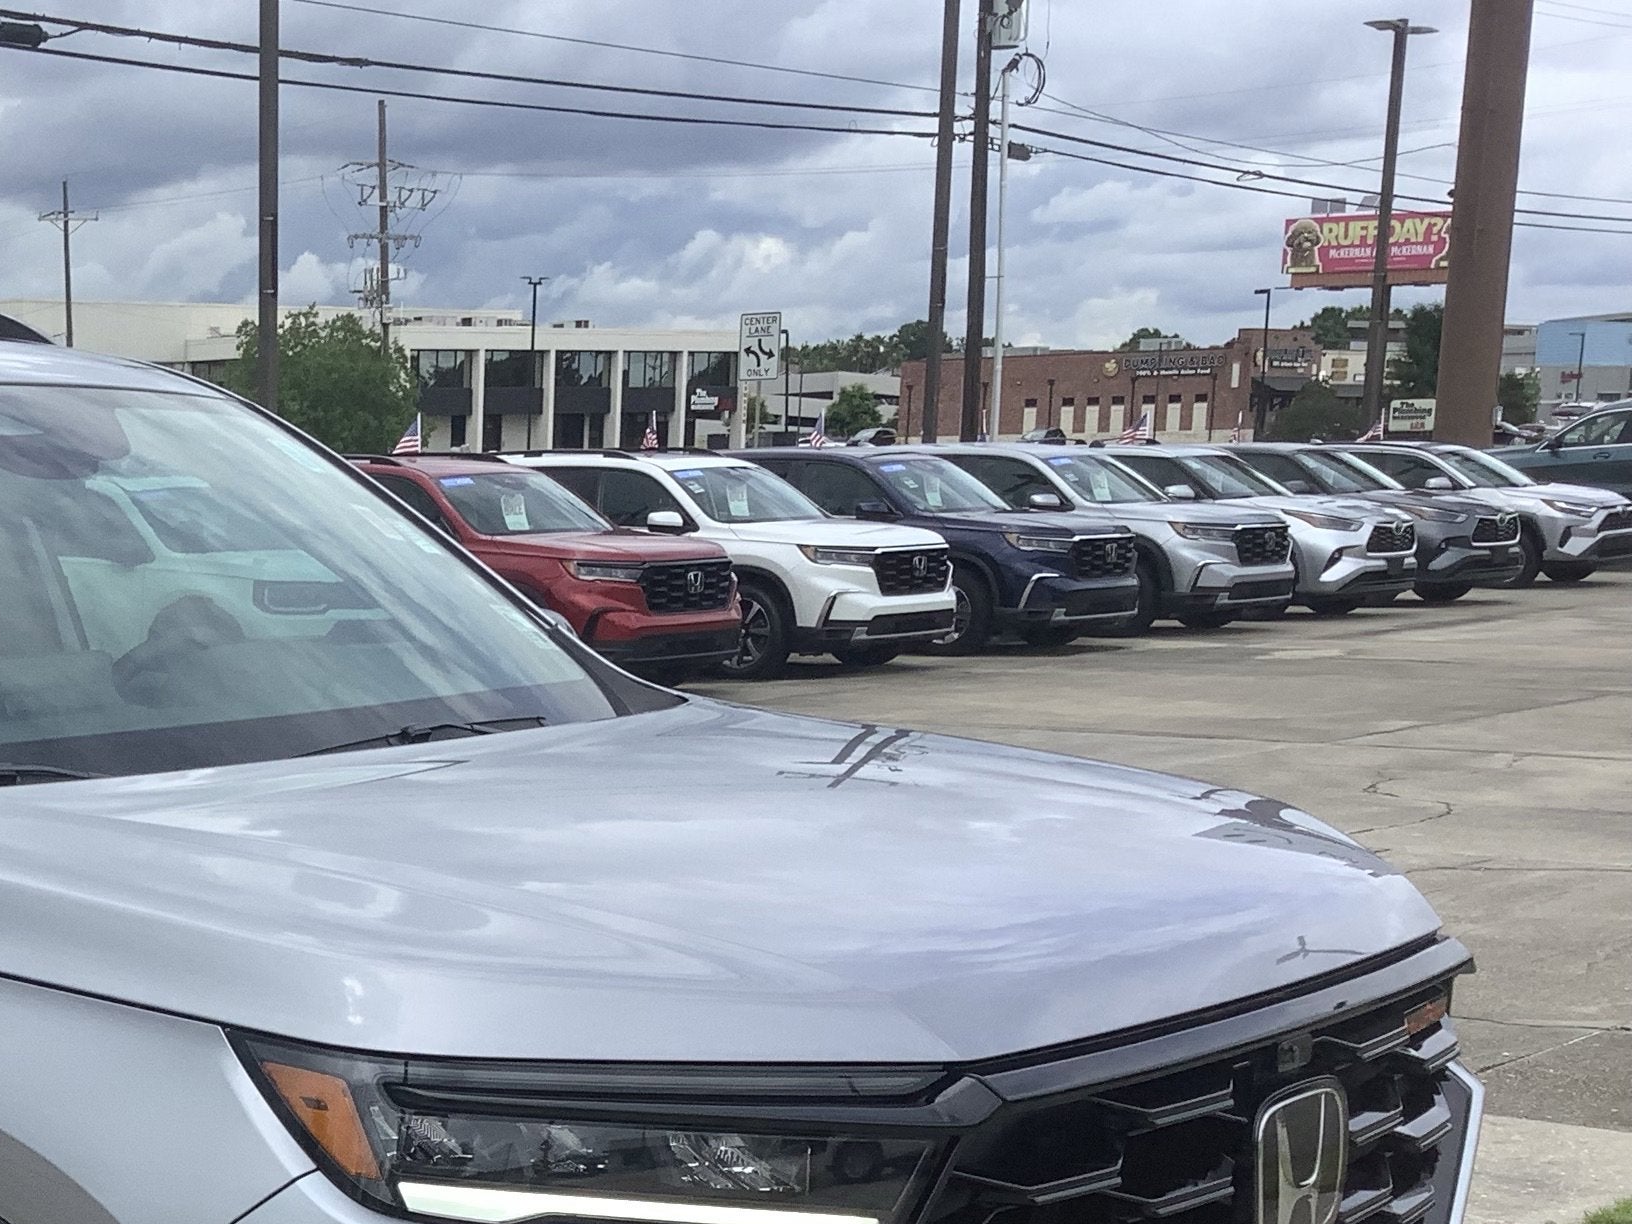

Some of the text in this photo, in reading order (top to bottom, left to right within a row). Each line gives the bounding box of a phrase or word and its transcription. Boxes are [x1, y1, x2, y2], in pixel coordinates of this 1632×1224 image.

[1323, 220, 1378, 246] RUFF
[744, 316, 778, 326] CENTER
[748, 326, 772, 335] LANE
[1123, 355, 1185, 369] DUMPING
[747, 368, 770, 377] ONLY
